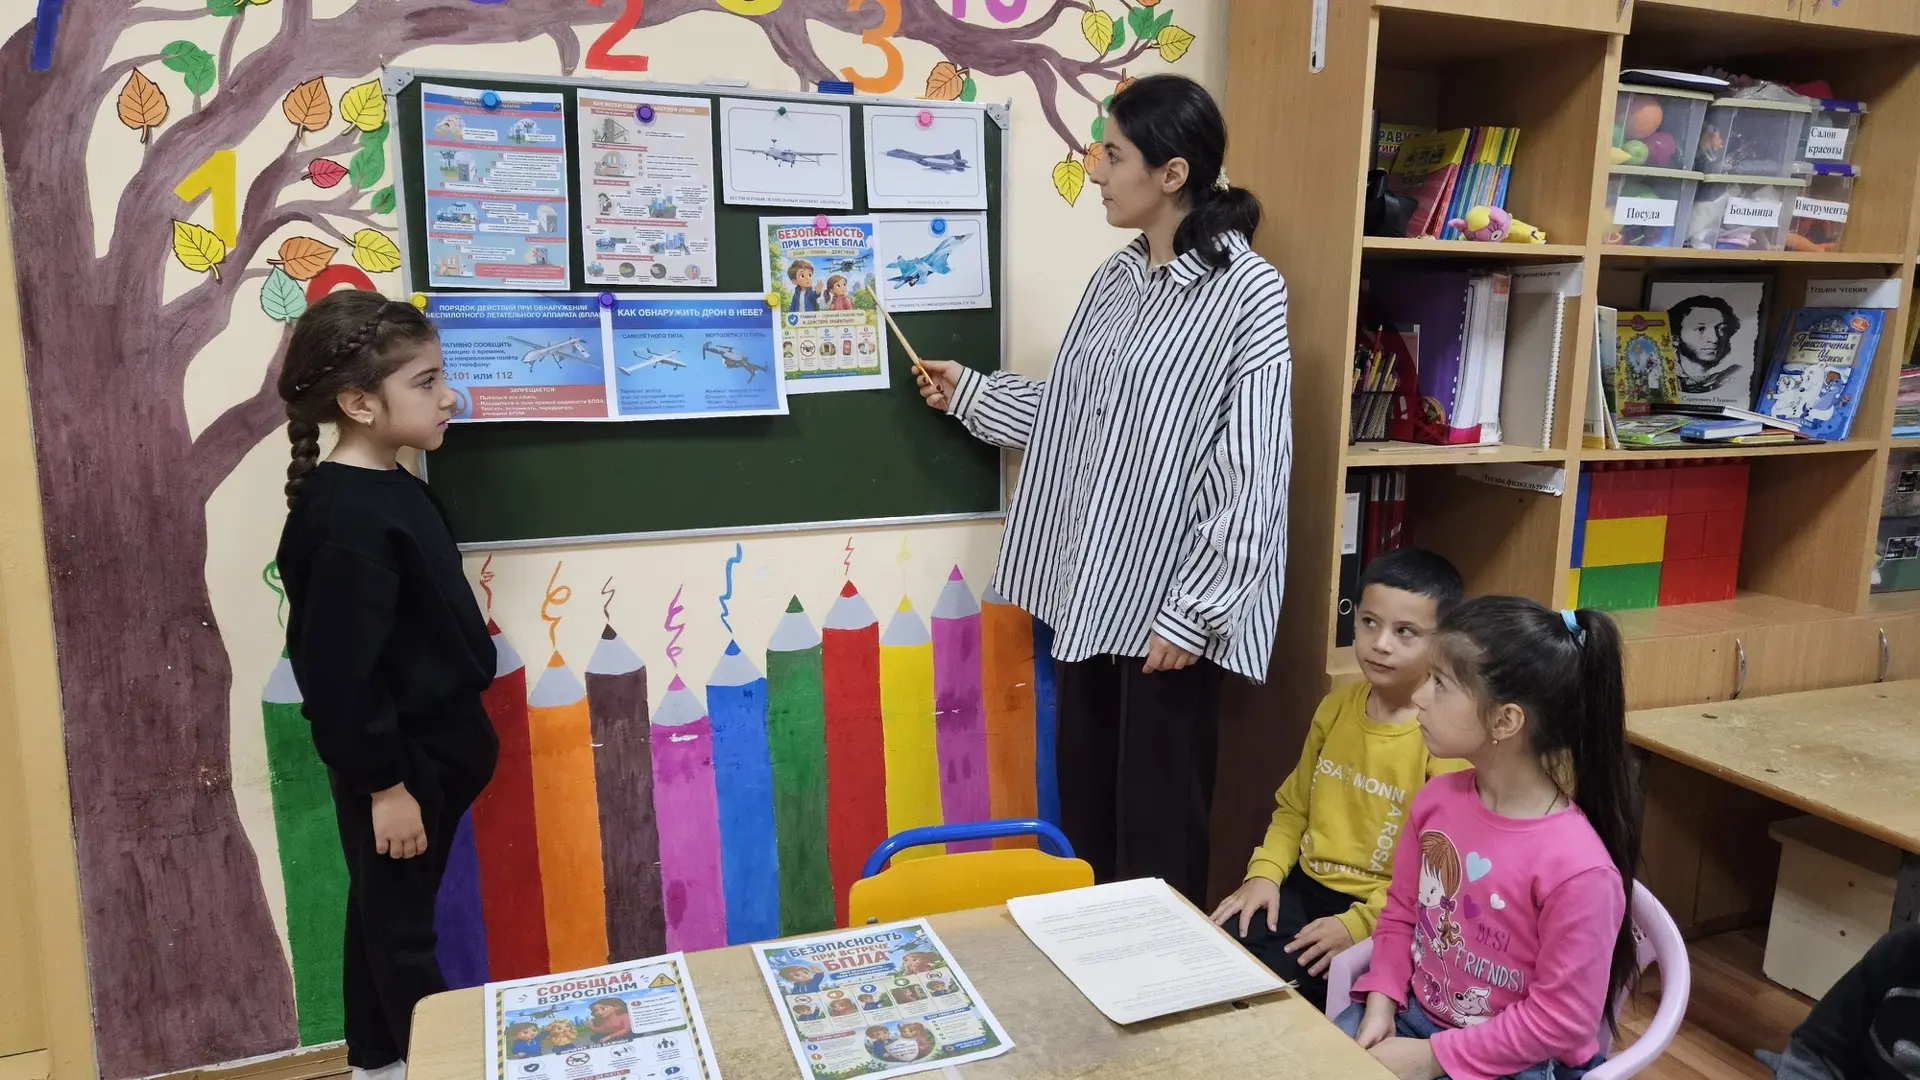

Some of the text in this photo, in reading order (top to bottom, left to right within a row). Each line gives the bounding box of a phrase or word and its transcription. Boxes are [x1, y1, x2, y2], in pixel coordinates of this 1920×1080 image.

[585, 0, 648, 72] 2
[838, 0, 904, 94] 3
[1810, 127, 1837, 139] Салон
[1807, 145, 1842, 156] красоты
[173, 149, 236, 249] 1
[1626, 208, 1661, 221] Посуда
[1729, 204, 1773, 217] Больница
[778, 228, 864, 240] БЕЗОПАСНОСТЬ
[782, 239, 864, 248] ПРИ ВСТРЕЧЕ БПЛА
[439, 304, 476, 312] ПОРЯДОК
[477, 304, 517, 312] ДЕЙСТВИЙ
[617, 309, 637, 317] КАК
[638, 309, 701, 317] ОБНАРУЖИТЬ
[702, 309, 727, 318] ДРОН
[473, 341, 512, 349] СООБЩИТЬ
[1792, 333, 1855, 351] Приключения
[444, 370, 470, 381] 2,101
[496, 371, 514, 380] 112
[1506, 478, 1555, 491] физкультуры
[788, 931, 903, 958] БЕЗОПАСНОСТЬ
[811, 942, 890, 961] ПРИ ВСТРЕЧЕ
[822, 950, 891, 972] БПЛА
[536, 972, 634, 997] СООБЩАЙ
[538, 982, 638, 1005] ВЗРОСЛЫМ
